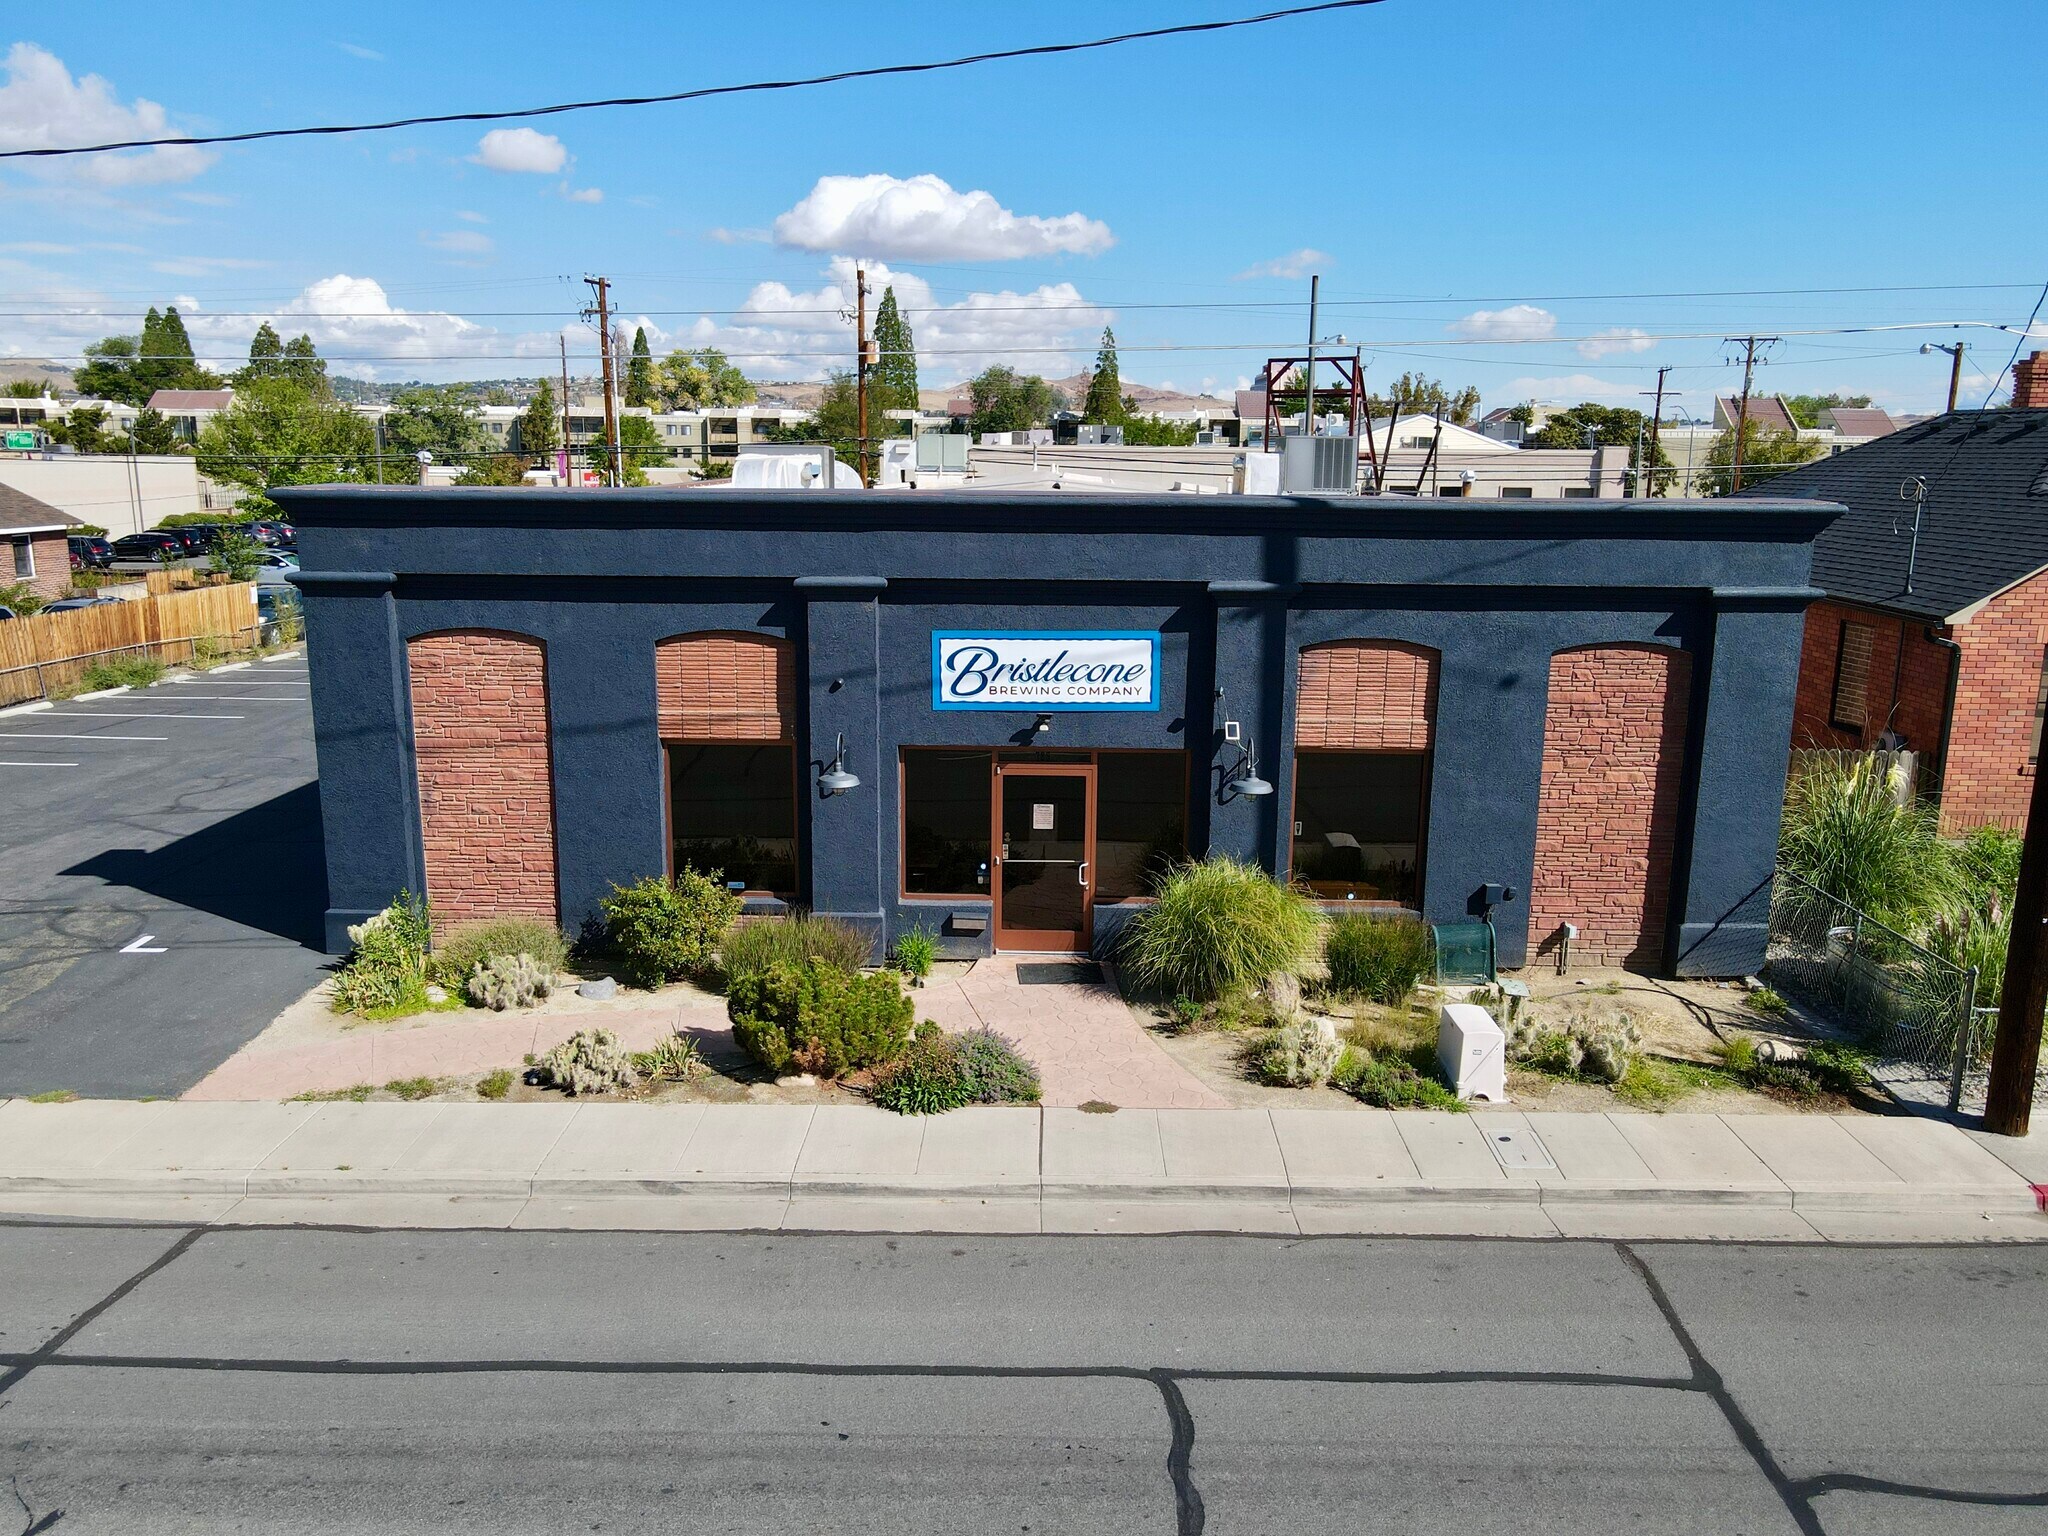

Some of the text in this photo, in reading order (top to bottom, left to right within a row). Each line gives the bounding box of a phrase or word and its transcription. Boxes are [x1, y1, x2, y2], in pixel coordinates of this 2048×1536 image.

[945, 646, 1147, 697] Bristlecone
[989, 685, 1143, 696] BREWING COMPANY
